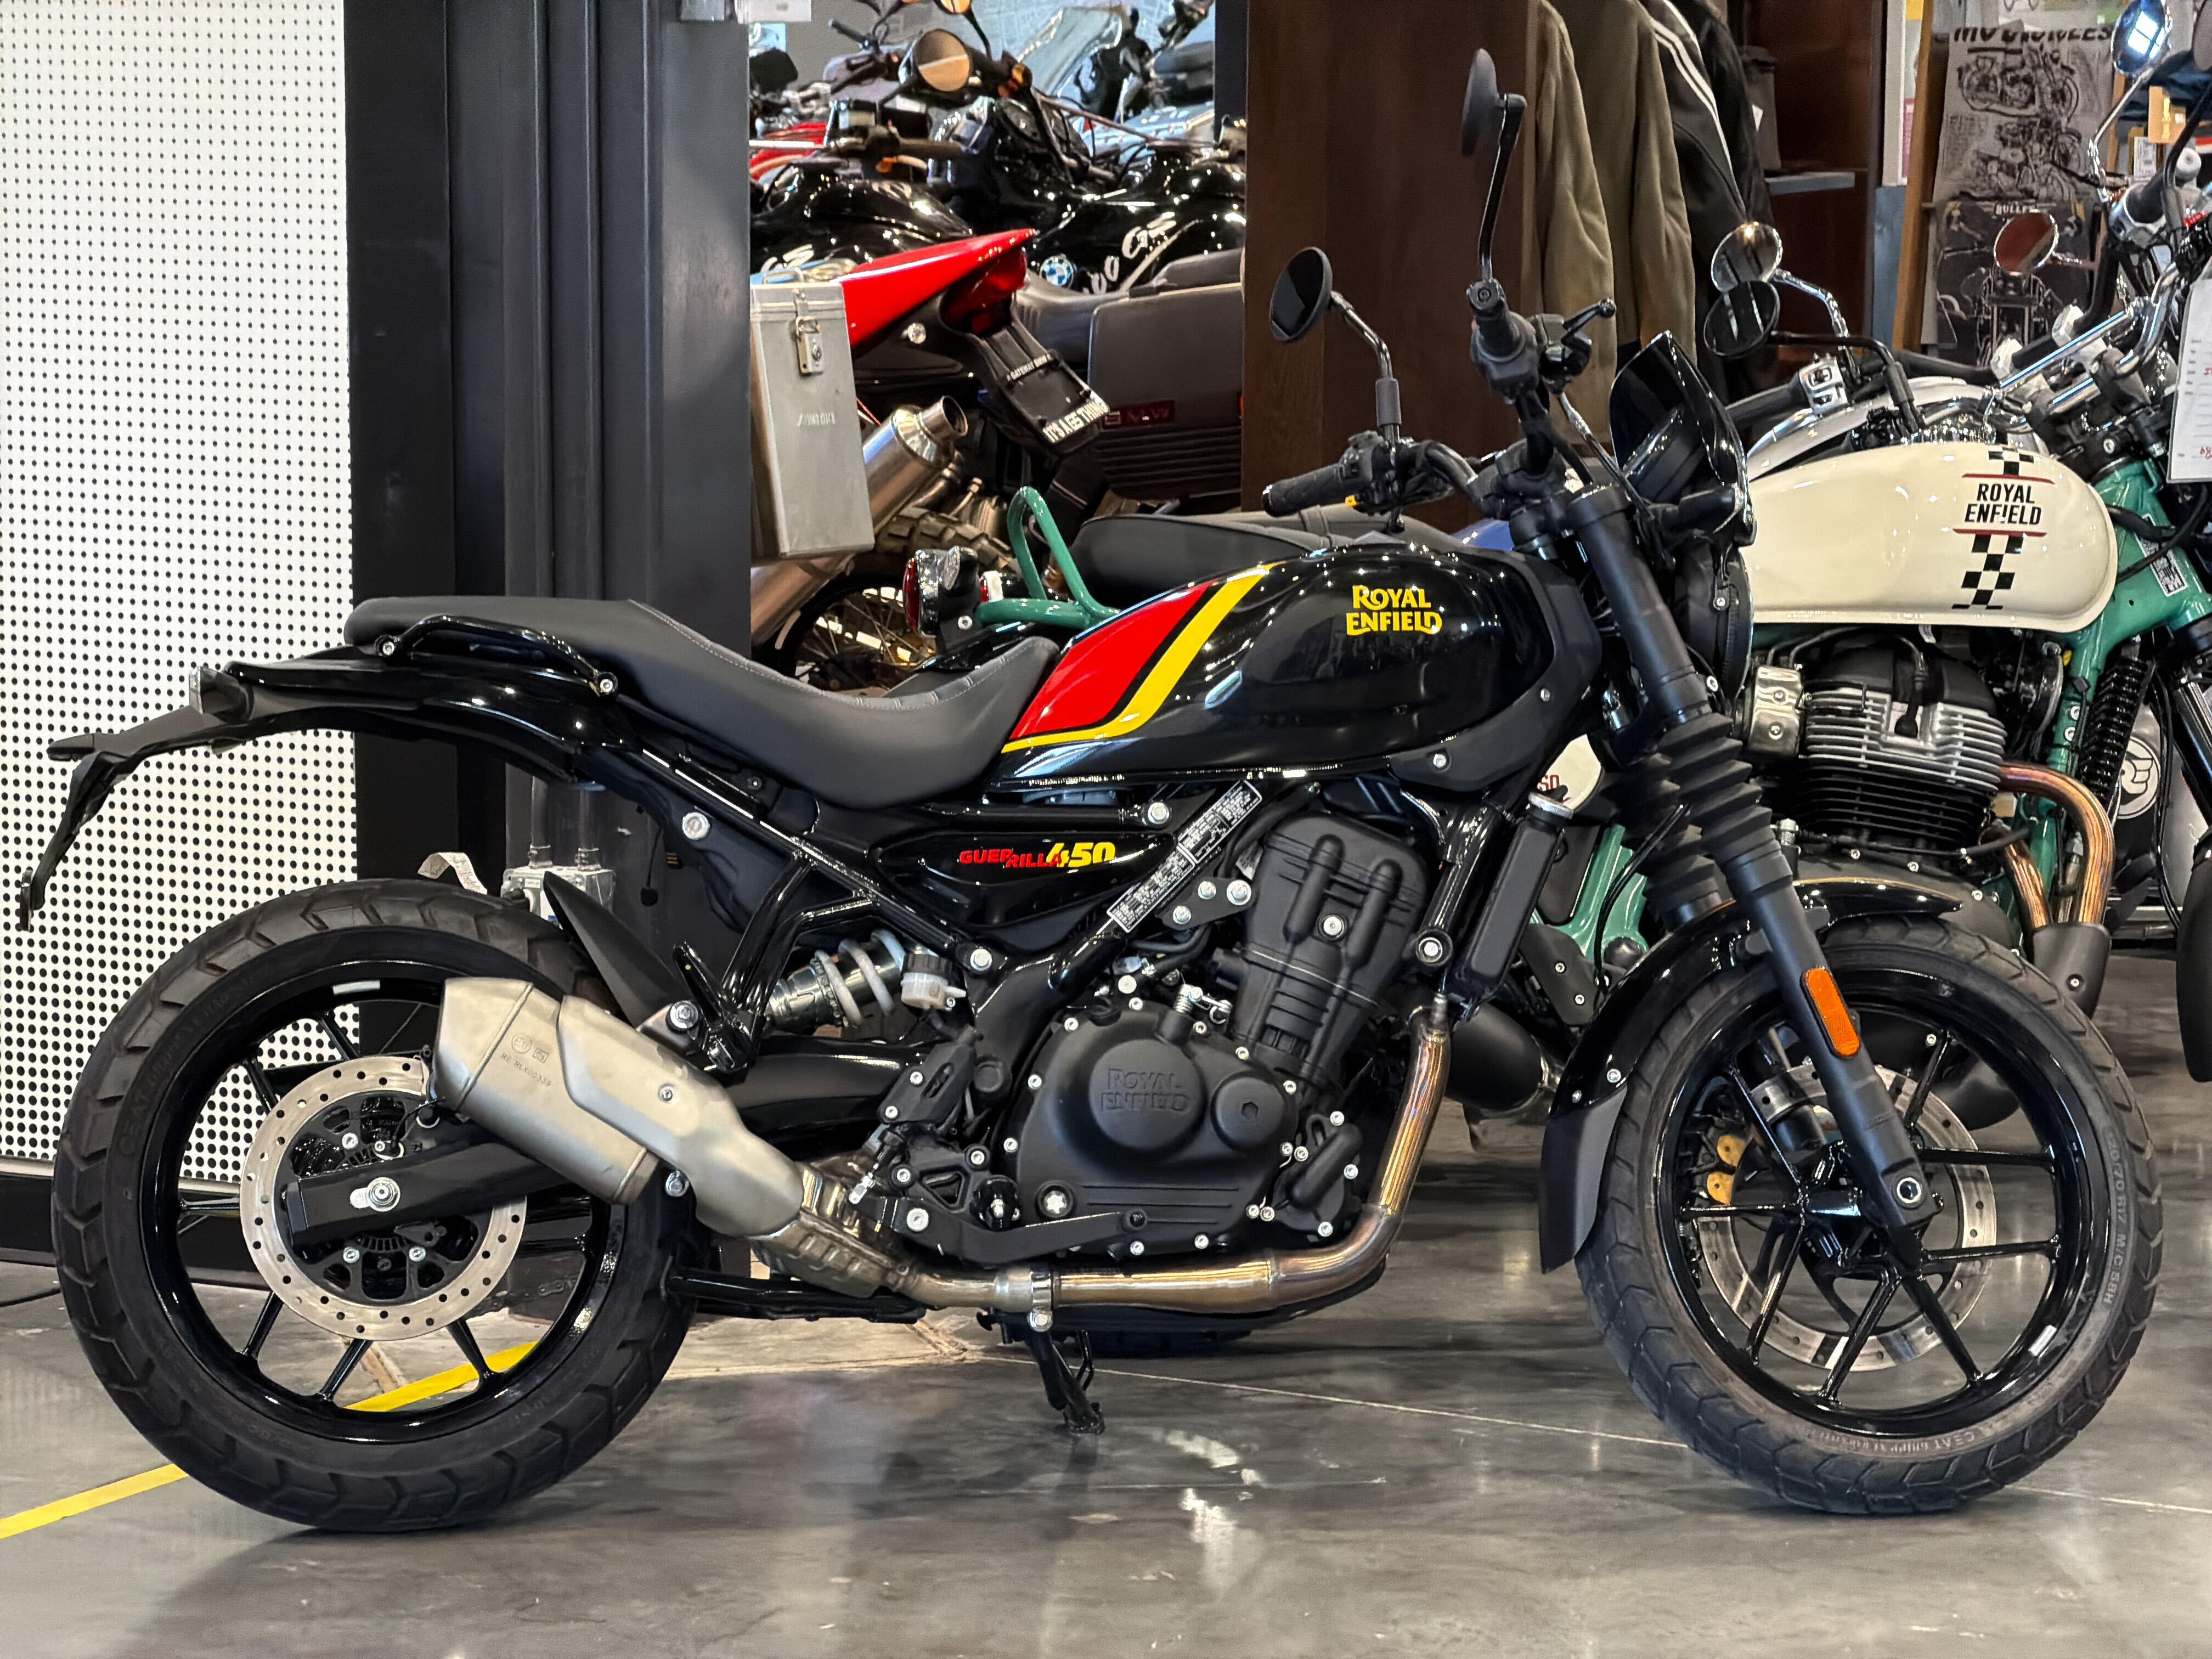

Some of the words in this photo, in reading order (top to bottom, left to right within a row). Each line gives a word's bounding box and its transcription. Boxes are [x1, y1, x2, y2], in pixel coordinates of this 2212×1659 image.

[1977, 483, 2035, 504] ROYAL
[1965, 503, 2041, 525] ENFIELD
[1352, 585, 1431, 610] ROYAL
[1346, 611, 1442, 636] ENFIELD
[960, 849, 1062, 868] GUERRILLA
[1046, 842, 1115, 867] 450
[1108, 1068, 1183, 1090] ROYAL
[1101, 1092, 1192, 1113] ENFIELD
[2114, 1234, 2126, 1267] M/C
